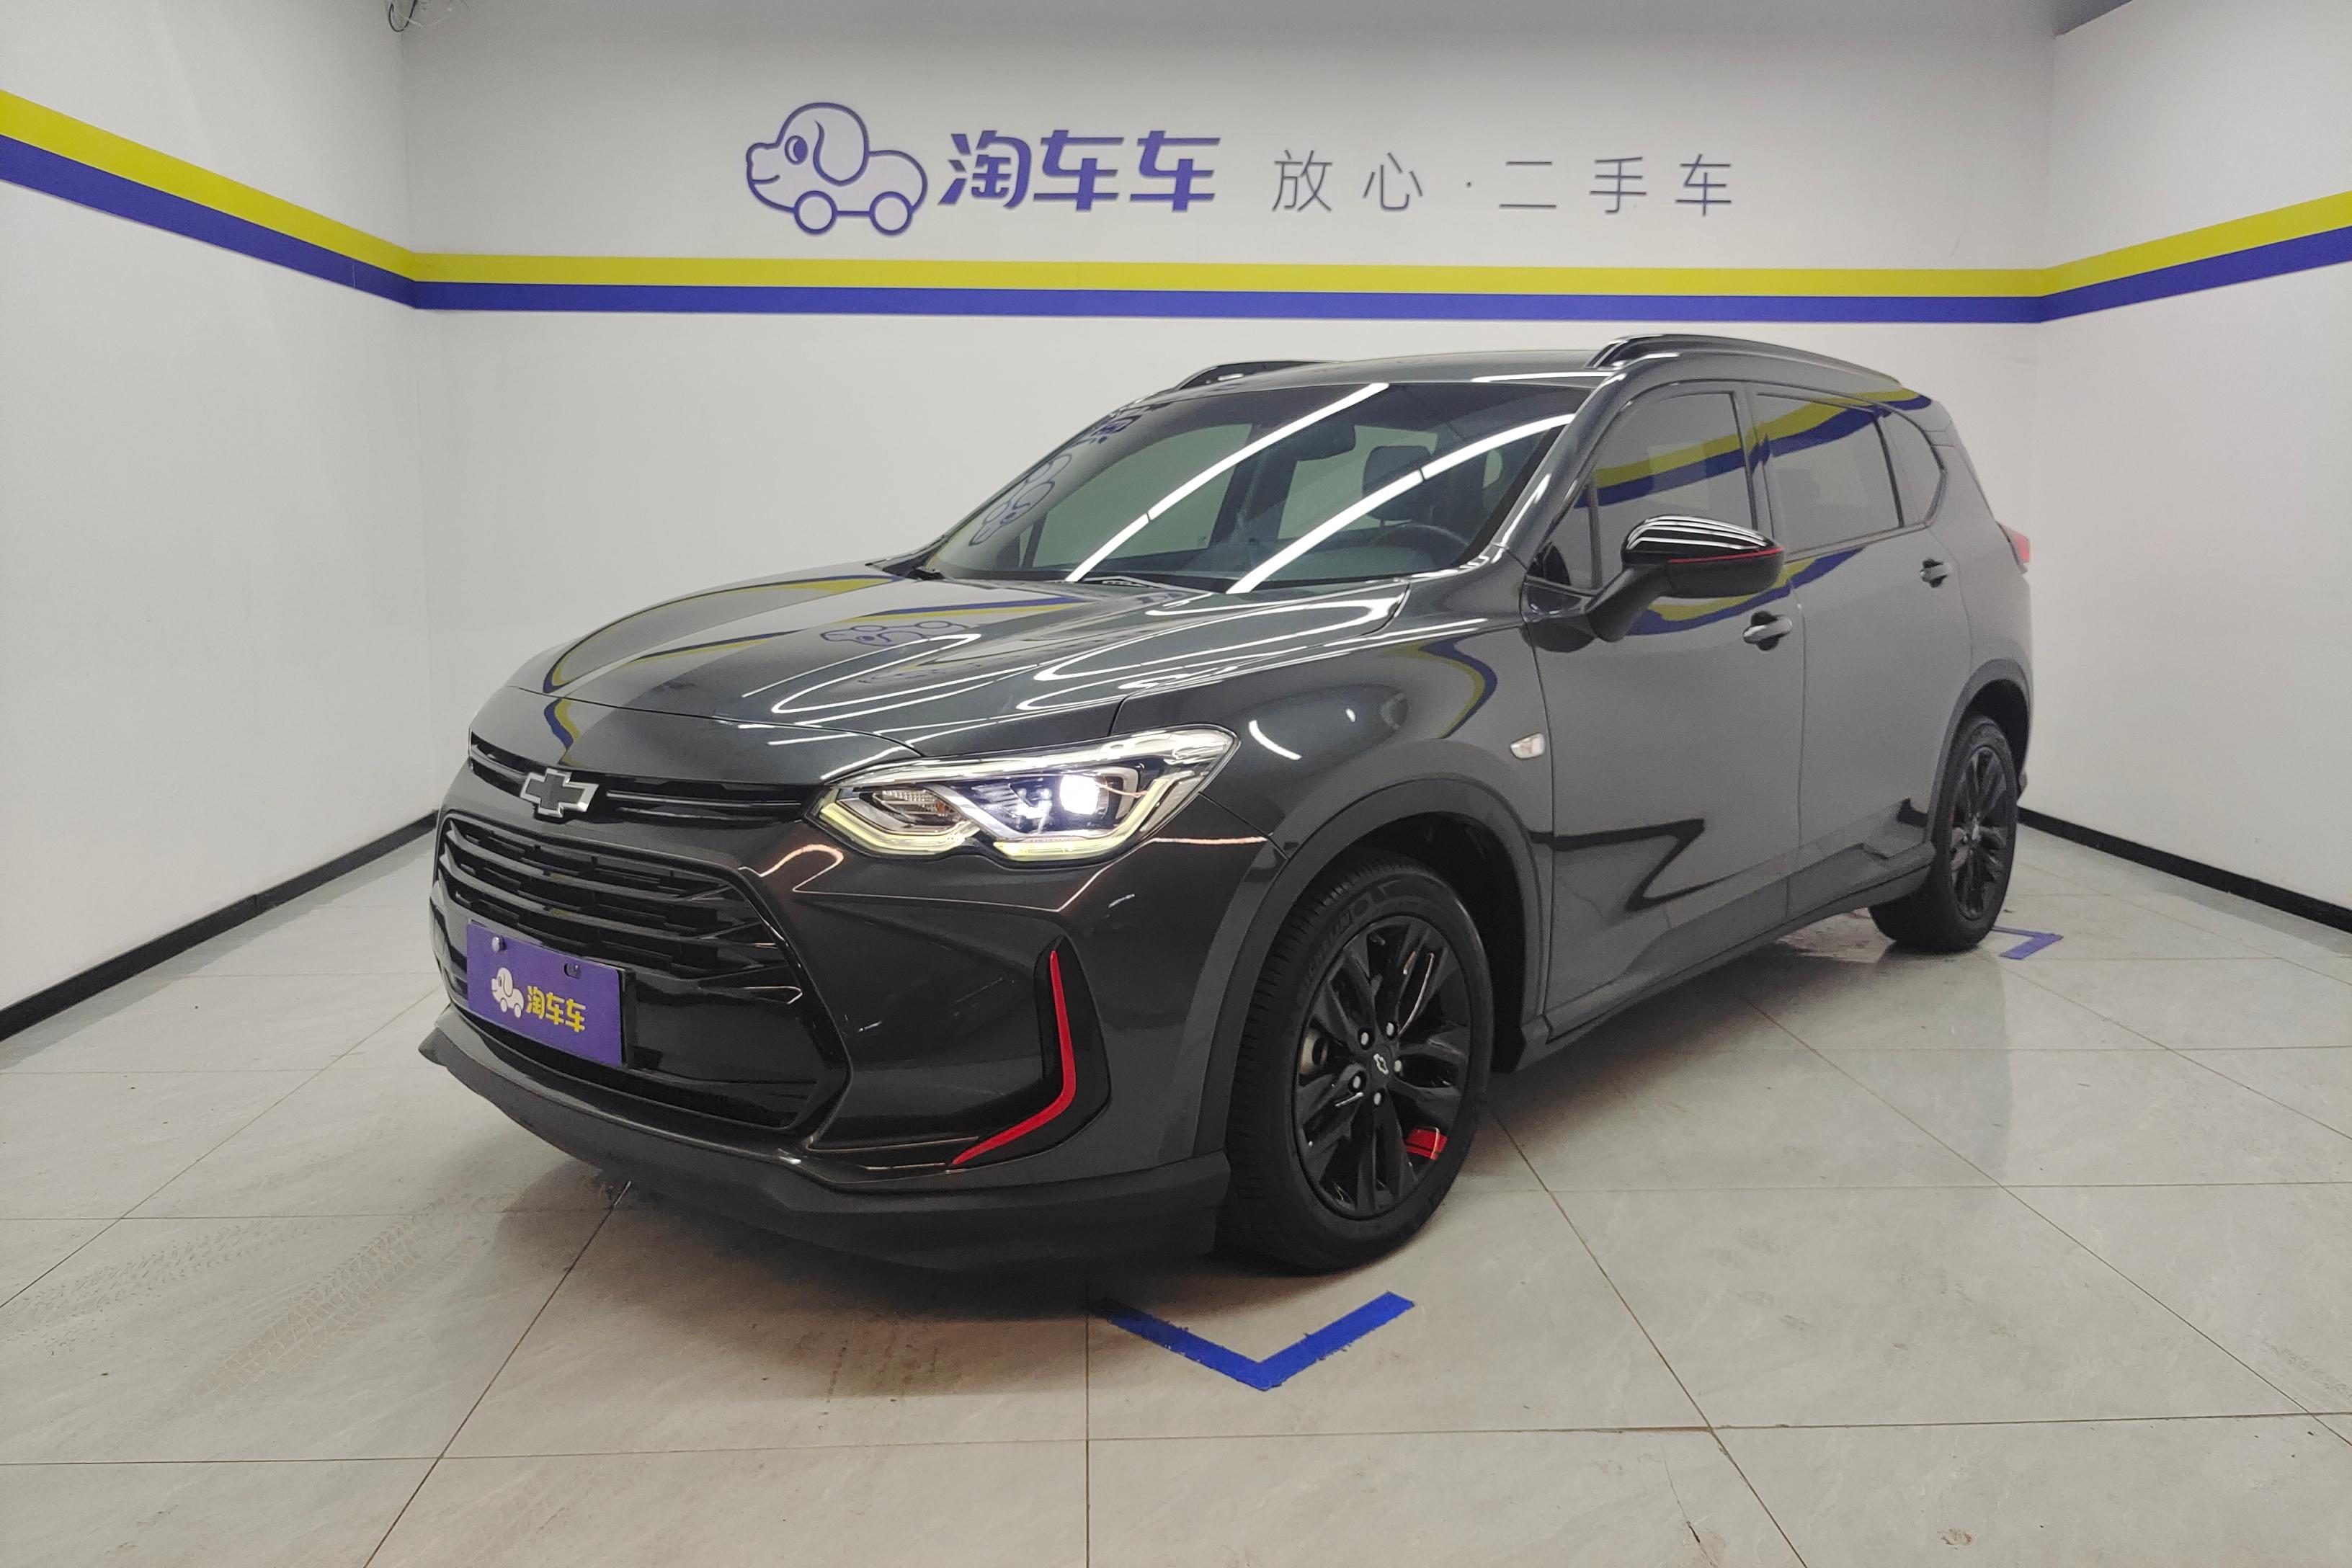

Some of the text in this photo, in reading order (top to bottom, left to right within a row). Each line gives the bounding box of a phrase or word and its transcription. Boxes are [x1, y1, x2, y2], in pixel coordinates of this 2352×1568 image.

[938, 130, 1220, 212] 淘车车
[526, 985, 587, 1033] 淘车车
